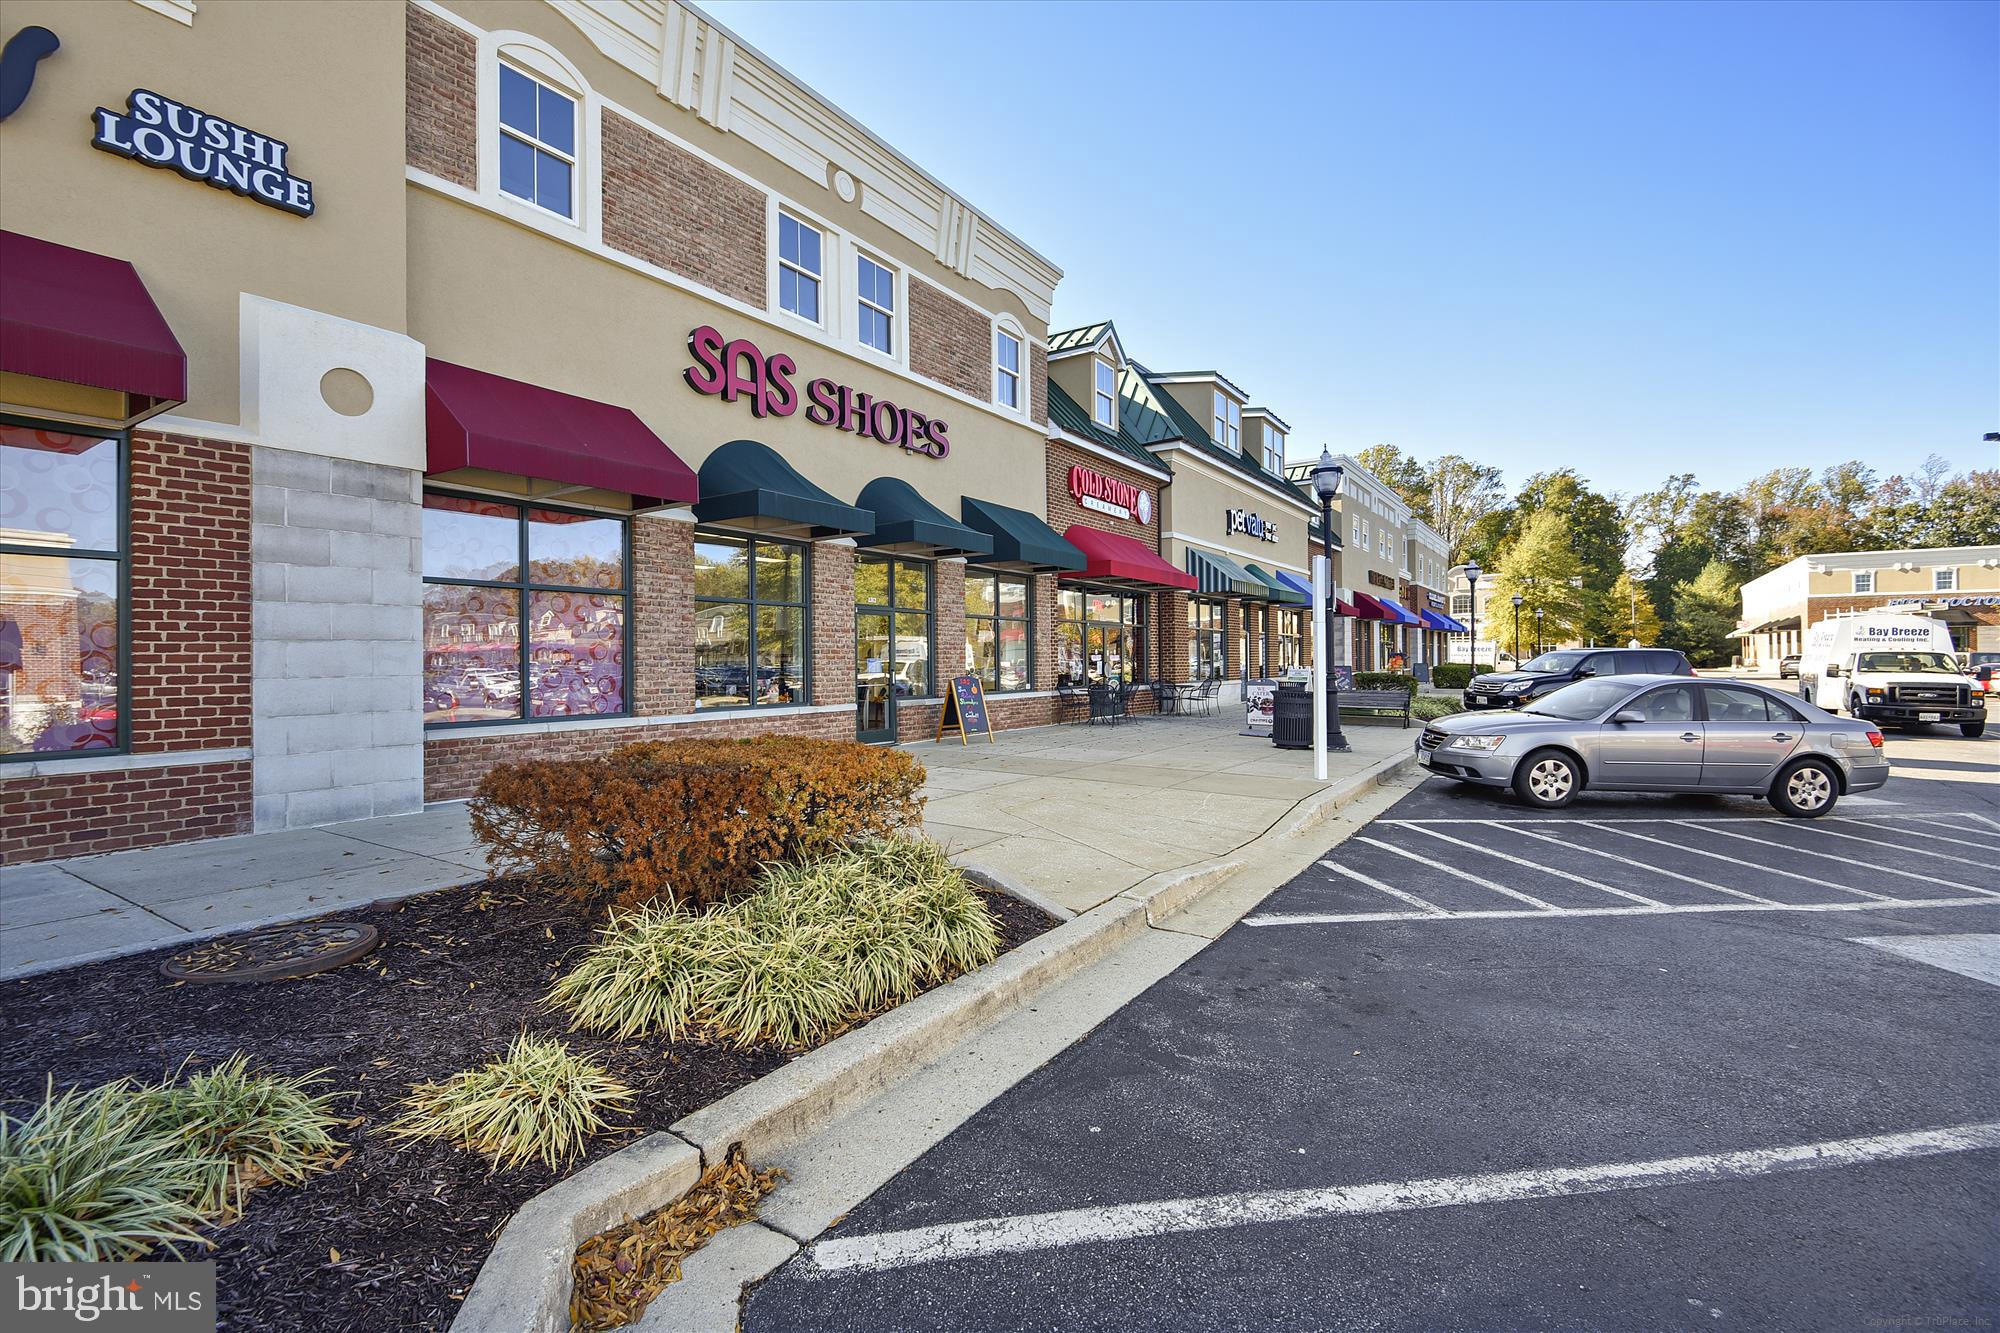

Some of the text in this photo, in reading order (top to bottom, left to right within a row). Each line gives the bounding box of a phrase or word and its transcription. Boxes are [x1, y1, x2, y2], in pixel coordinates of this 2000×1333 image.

[100, 111, 312, 211] LOUNGE
[134, 92, 285, 171] SUSHI
[683, 325, 950, 459] SAS SHOES
[1072, 464, 1138, 516] COLD STONE
[1869, 627, 1930, 637] Bay Breeze
[1937, 595, 2000, 607] DOCTO
